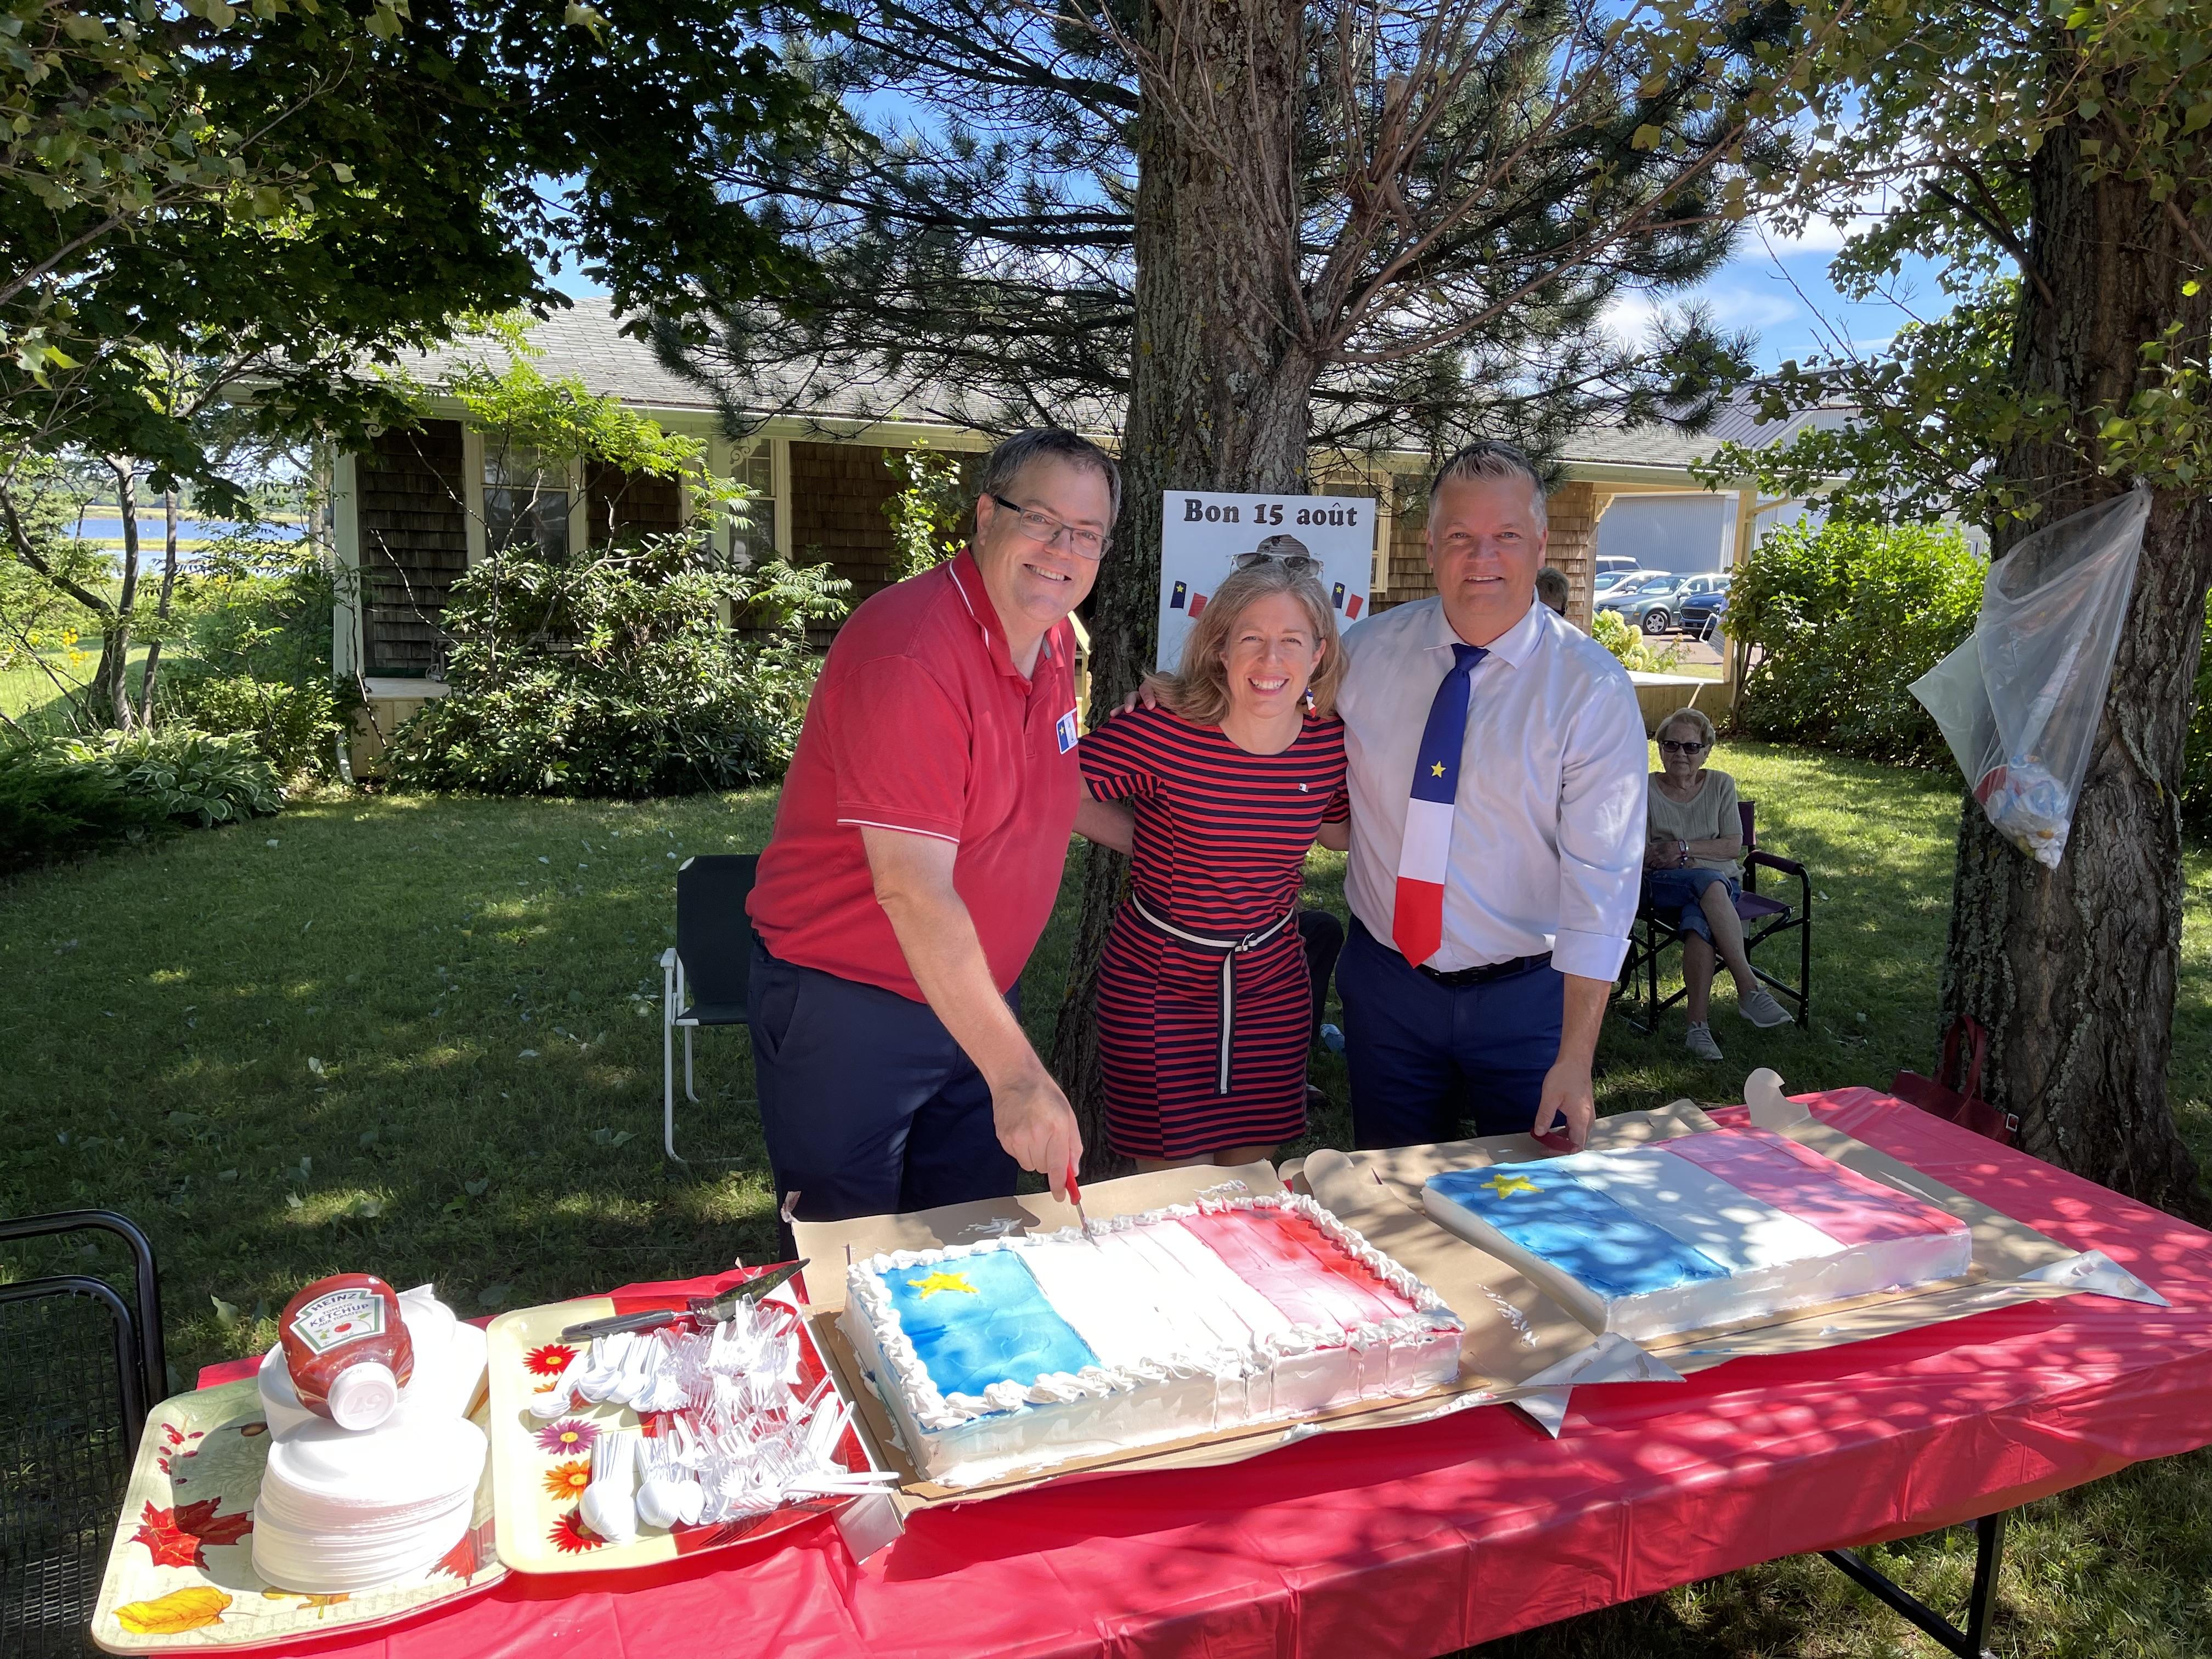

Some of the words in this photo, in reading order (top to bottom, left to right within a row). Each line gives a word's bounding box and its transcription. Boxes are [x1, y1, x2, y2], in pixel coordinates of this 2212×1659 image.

[1183, 499, 1240, 523] Bon
[1254, 504, 1284, 526] 15
[1296, 502, 1358, 527] août
[311, 1293, 357, 1311] HEINZ
[321, 1303, 353, 1315] TOMATO
[309, 1304, 369, 1327] KETCHUP
